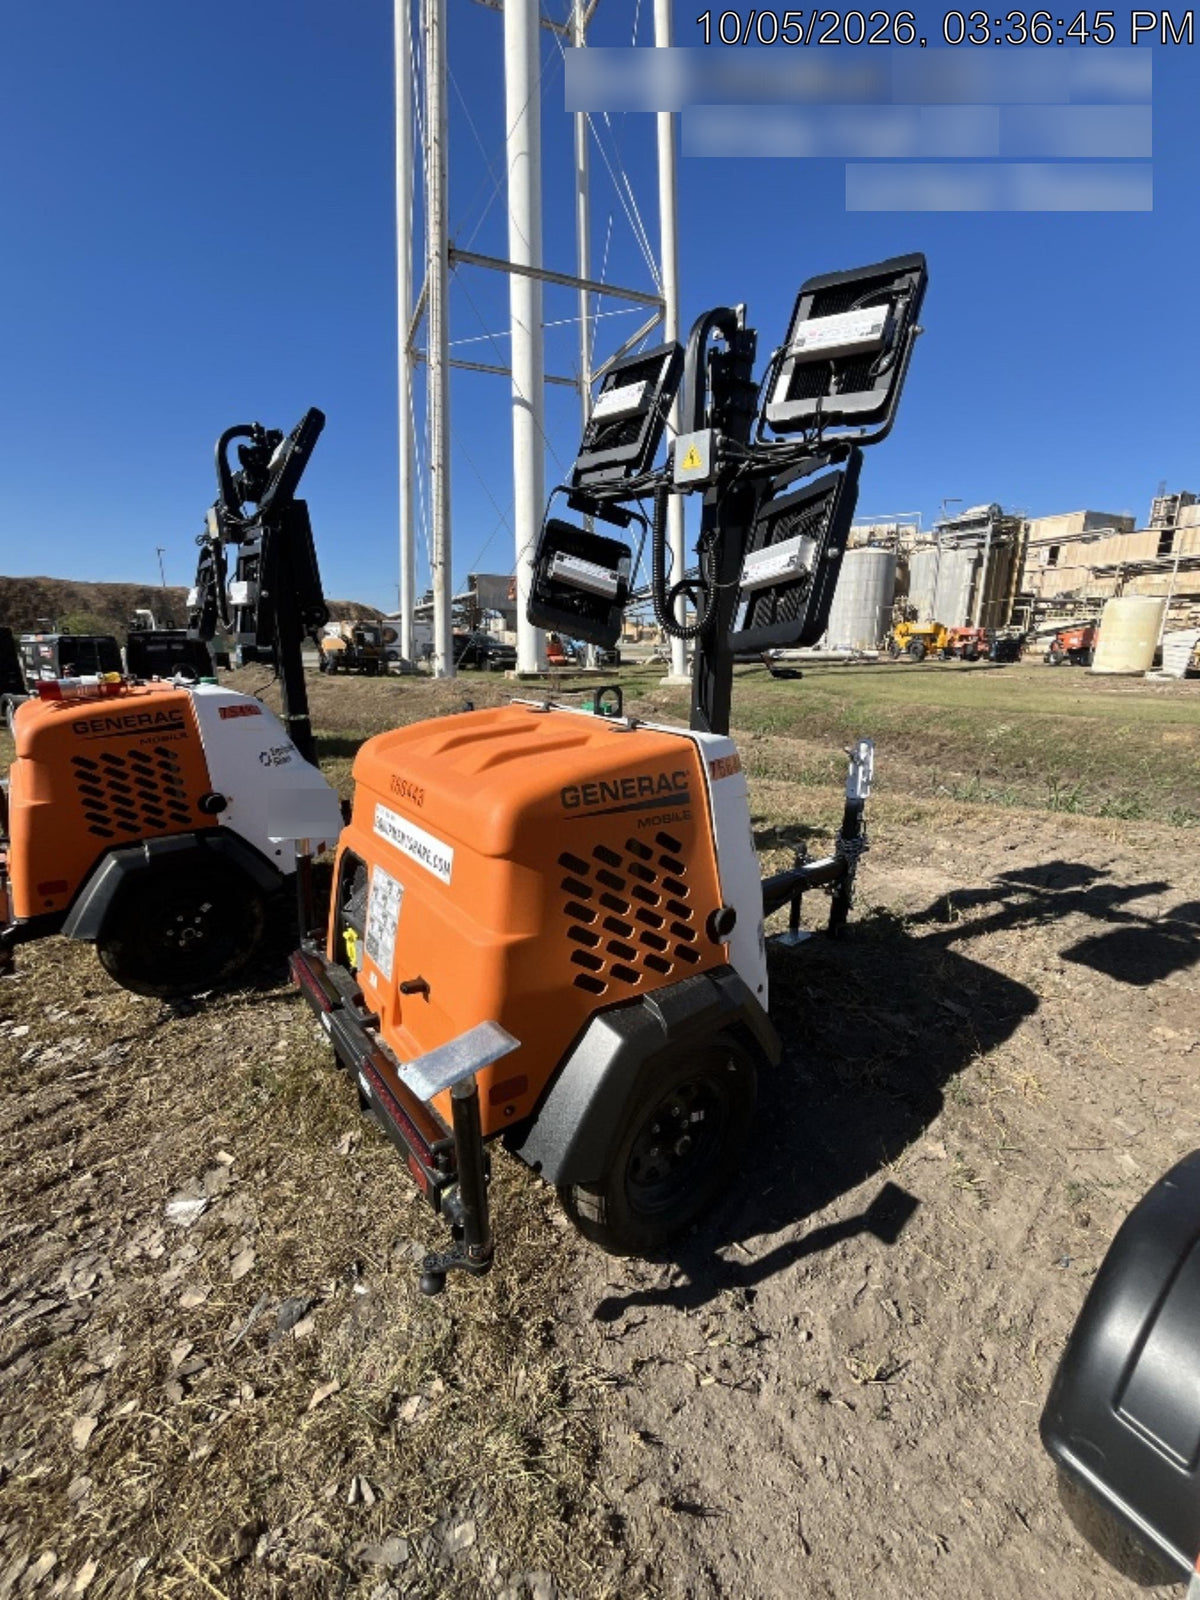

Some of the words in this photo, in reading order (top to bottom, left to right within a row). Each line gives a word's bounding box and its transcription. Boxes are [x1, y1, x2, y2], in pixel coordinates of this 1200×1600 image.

[72, 709, 183, 735] GENERAC
[560, 769, 689, 809] GENERAC
[637, 810, 692, 829] MOBILE
